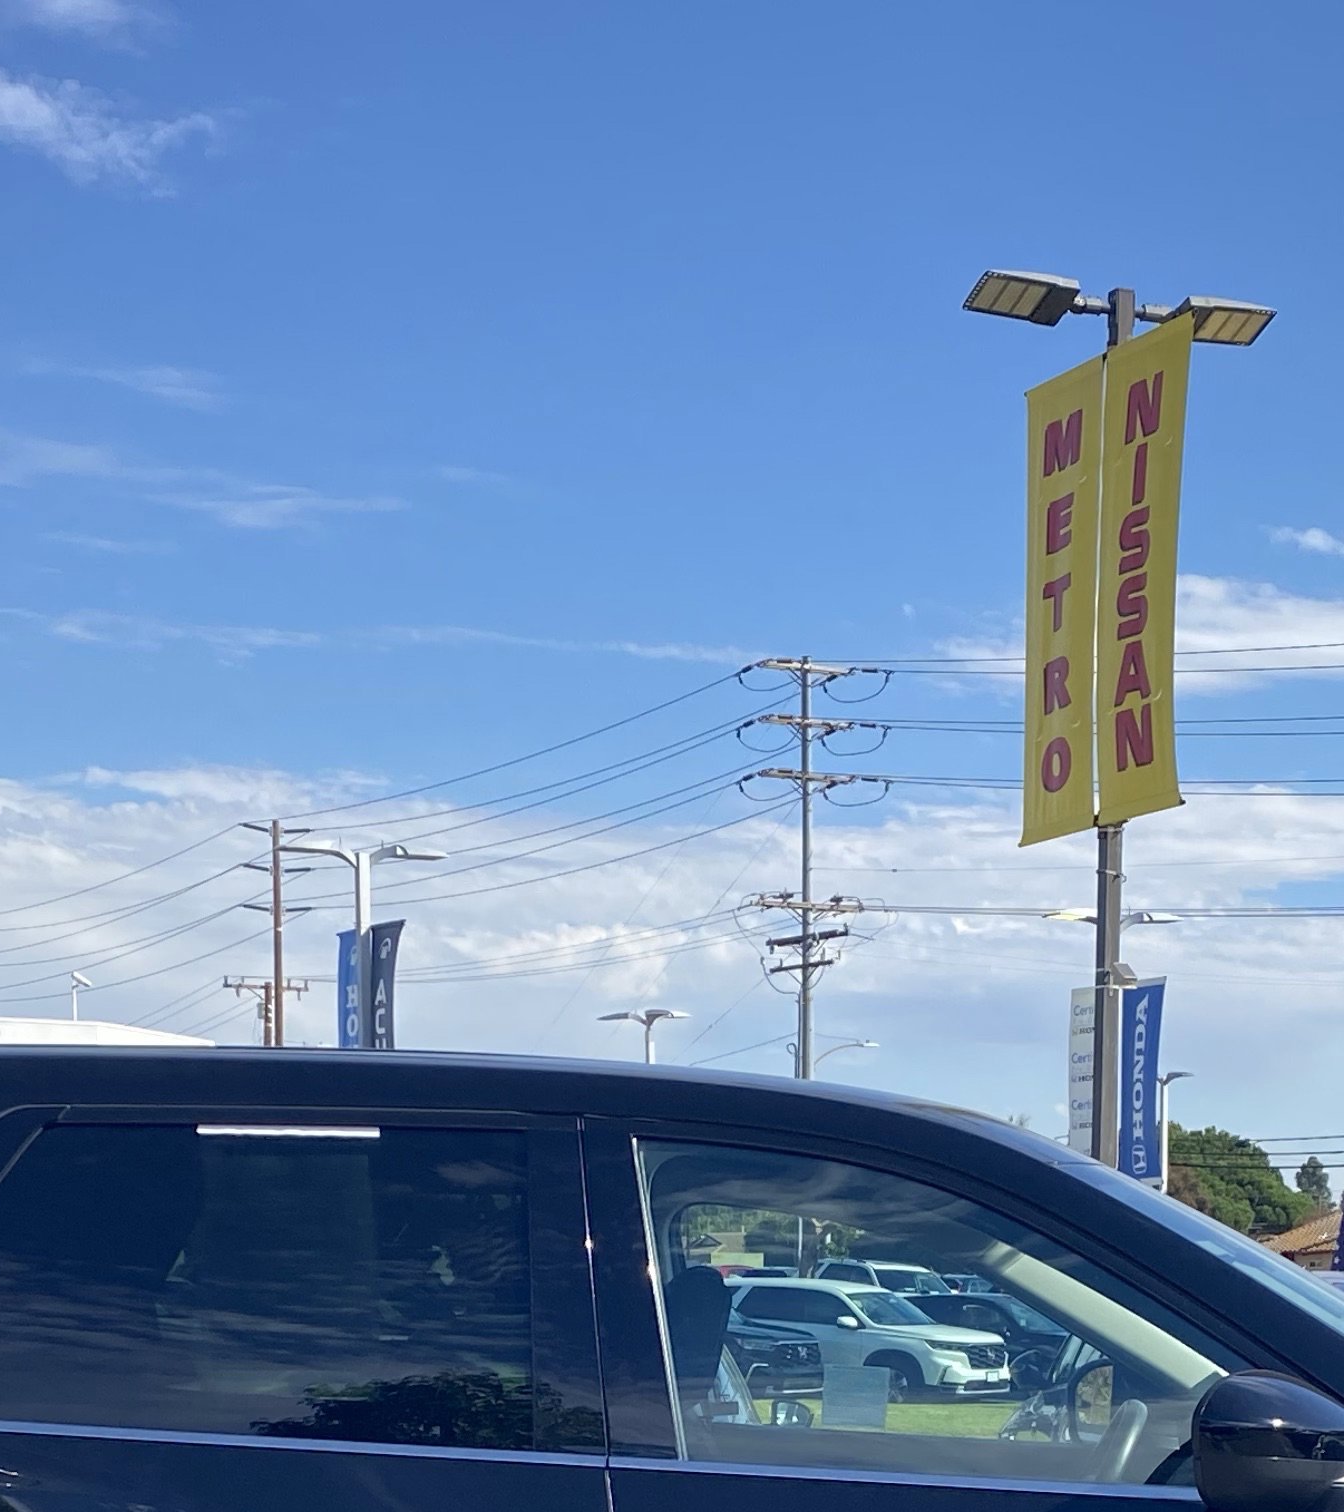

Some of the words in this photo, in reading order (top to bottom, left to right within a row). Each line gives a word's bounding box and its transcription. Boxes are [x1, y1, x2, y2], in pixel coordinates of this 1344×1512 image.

[1041, 409, 1083, 794] METRO
[1114, 370, 1164, 773] NISSAN
[1132, 993, 1149, 1141] HONDA
